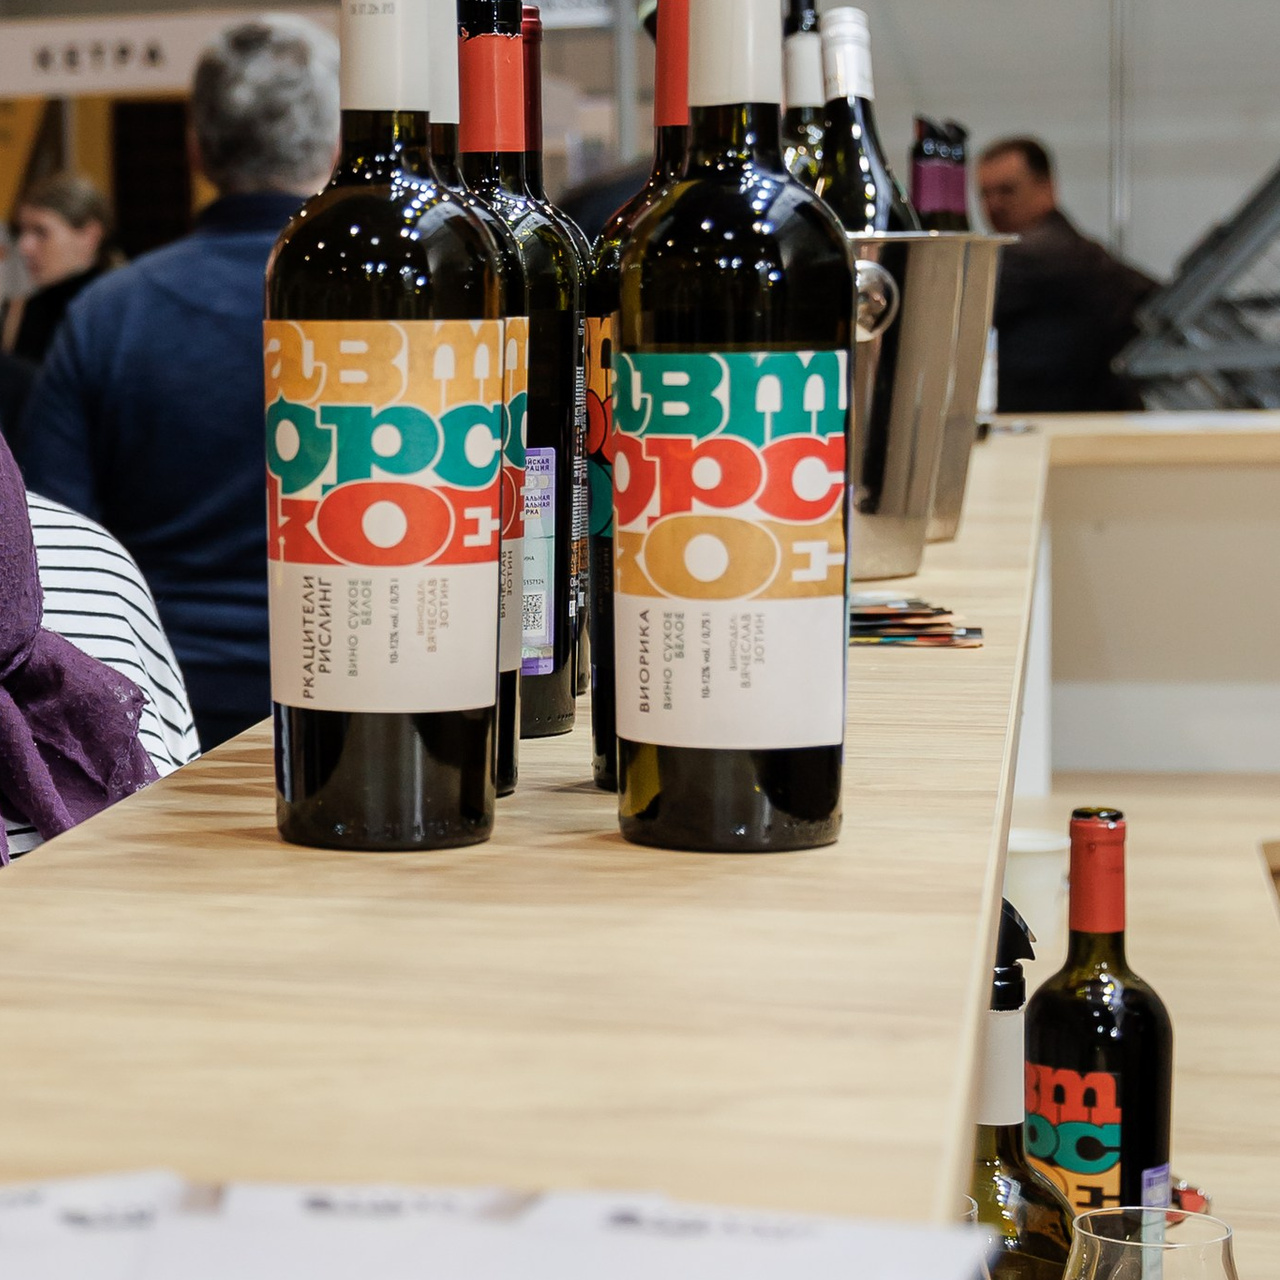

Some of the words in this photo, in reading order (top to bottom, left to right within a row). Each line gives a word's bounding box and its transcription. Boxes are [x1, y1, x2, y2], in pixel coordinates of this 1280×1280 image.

[318, 577, 332, 675] РИСЛИНГ
[347, 578, 359, 630] СУХОЕ
[361, 579, 372, 626] БЕЛОЕ
[426, 577, 438, 653] ВЯЧЕСЛАВ
[439, 577, 450, 629] ЗОТИН
[302, 575, 316, 700] РКАЦИТЕЛИ
[347, 634, 359, 677] ВИНО
[663, 611, 673, 663] СУХОЕ
[675, 611, 685, 659] БЕЛОЕ
[740, 613, 751, 689] ВЯЧЕСЛАВ
[754, 613, 765, 665] ЗОТИН
[639, 609, 650, 714] ВИОРИКА
[663, 668, 673, 711] ВИНО
